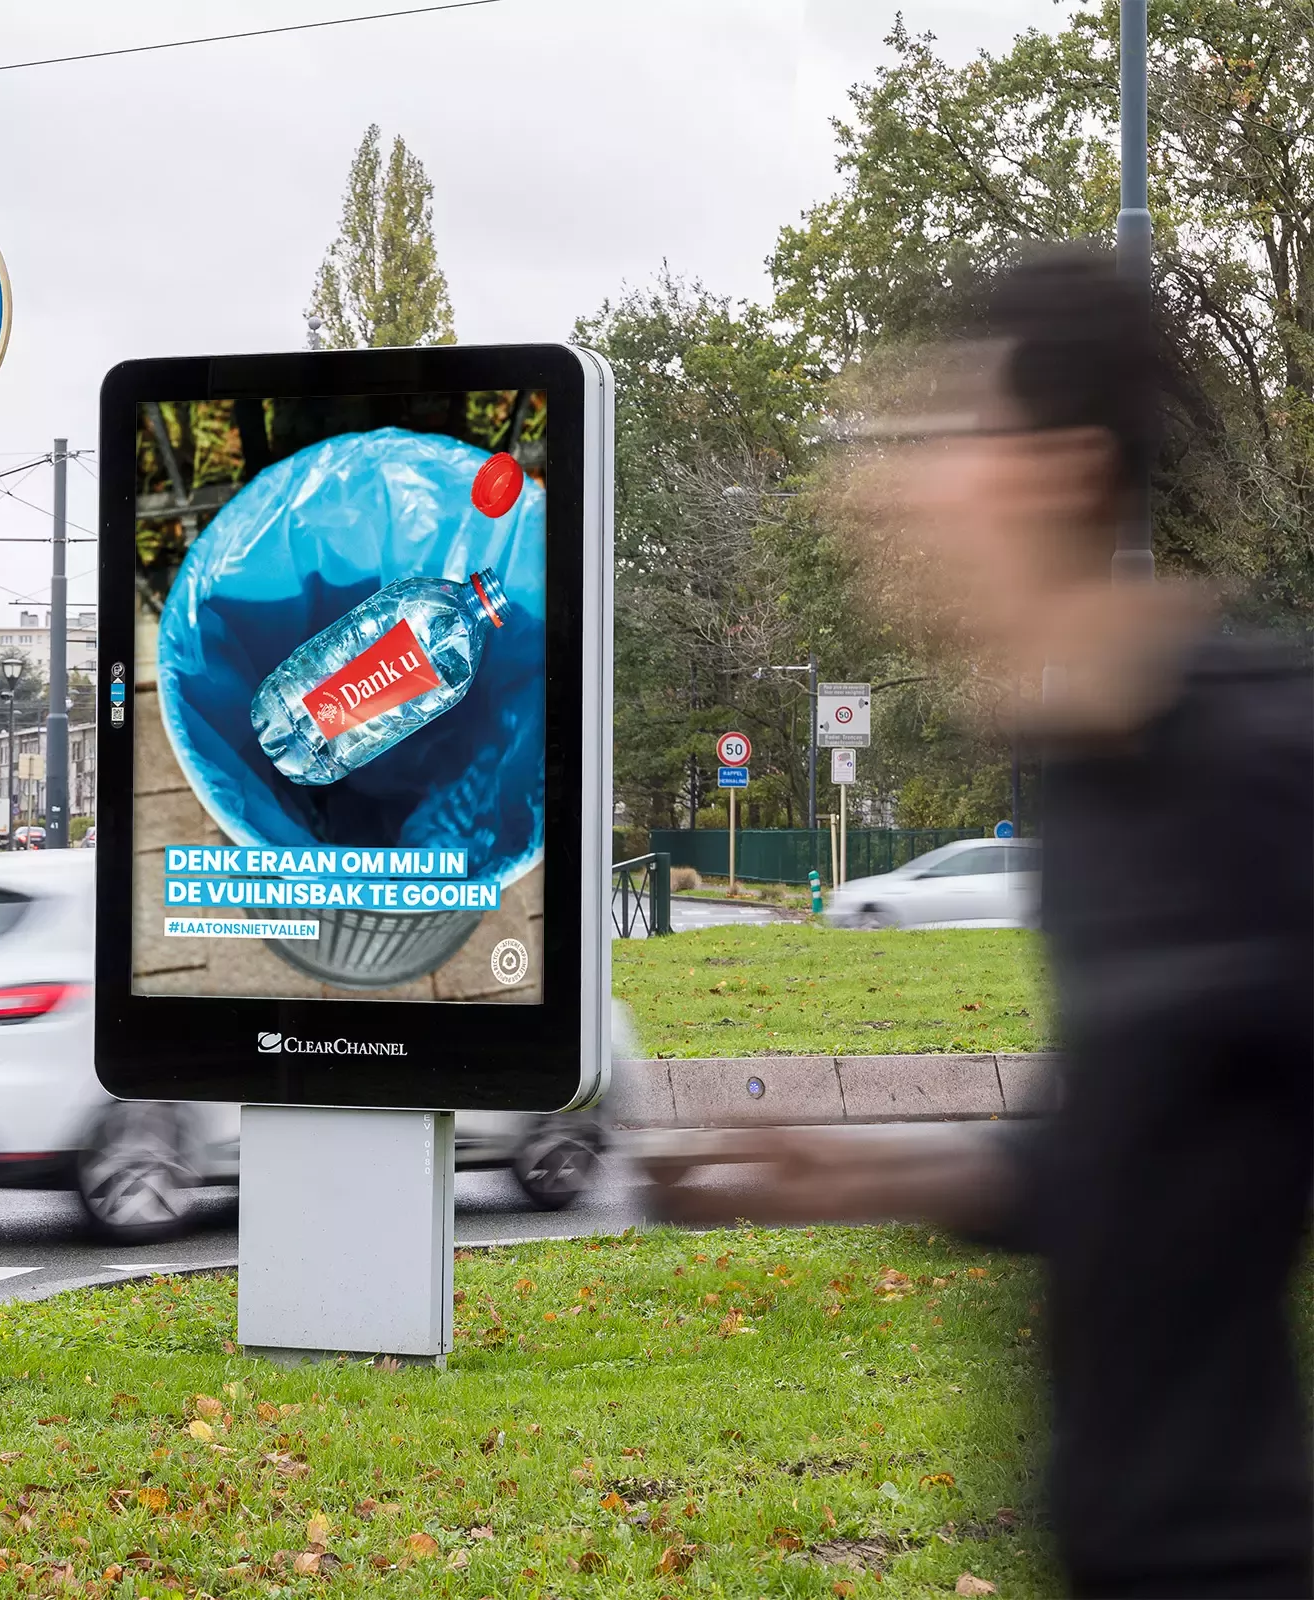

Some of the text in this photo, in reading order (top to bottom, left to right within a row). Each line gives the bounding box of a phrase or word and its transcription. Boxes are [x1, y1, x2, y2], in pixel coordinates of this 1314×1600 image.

[338, 650, 421, 710] Dank u
[839, 711, 849, 719] 50
[726, 743, 743, 755] 50
[168, 849, 464, 874] DENK ERAAN OM MIJ IN
[168, 881, 497, 907] DE VUILNISBAK TE GOOIEN
[168, 921, 316, 936] #LAATONSNIETVALLEN
[423, 1113, 431, 1130] EV
